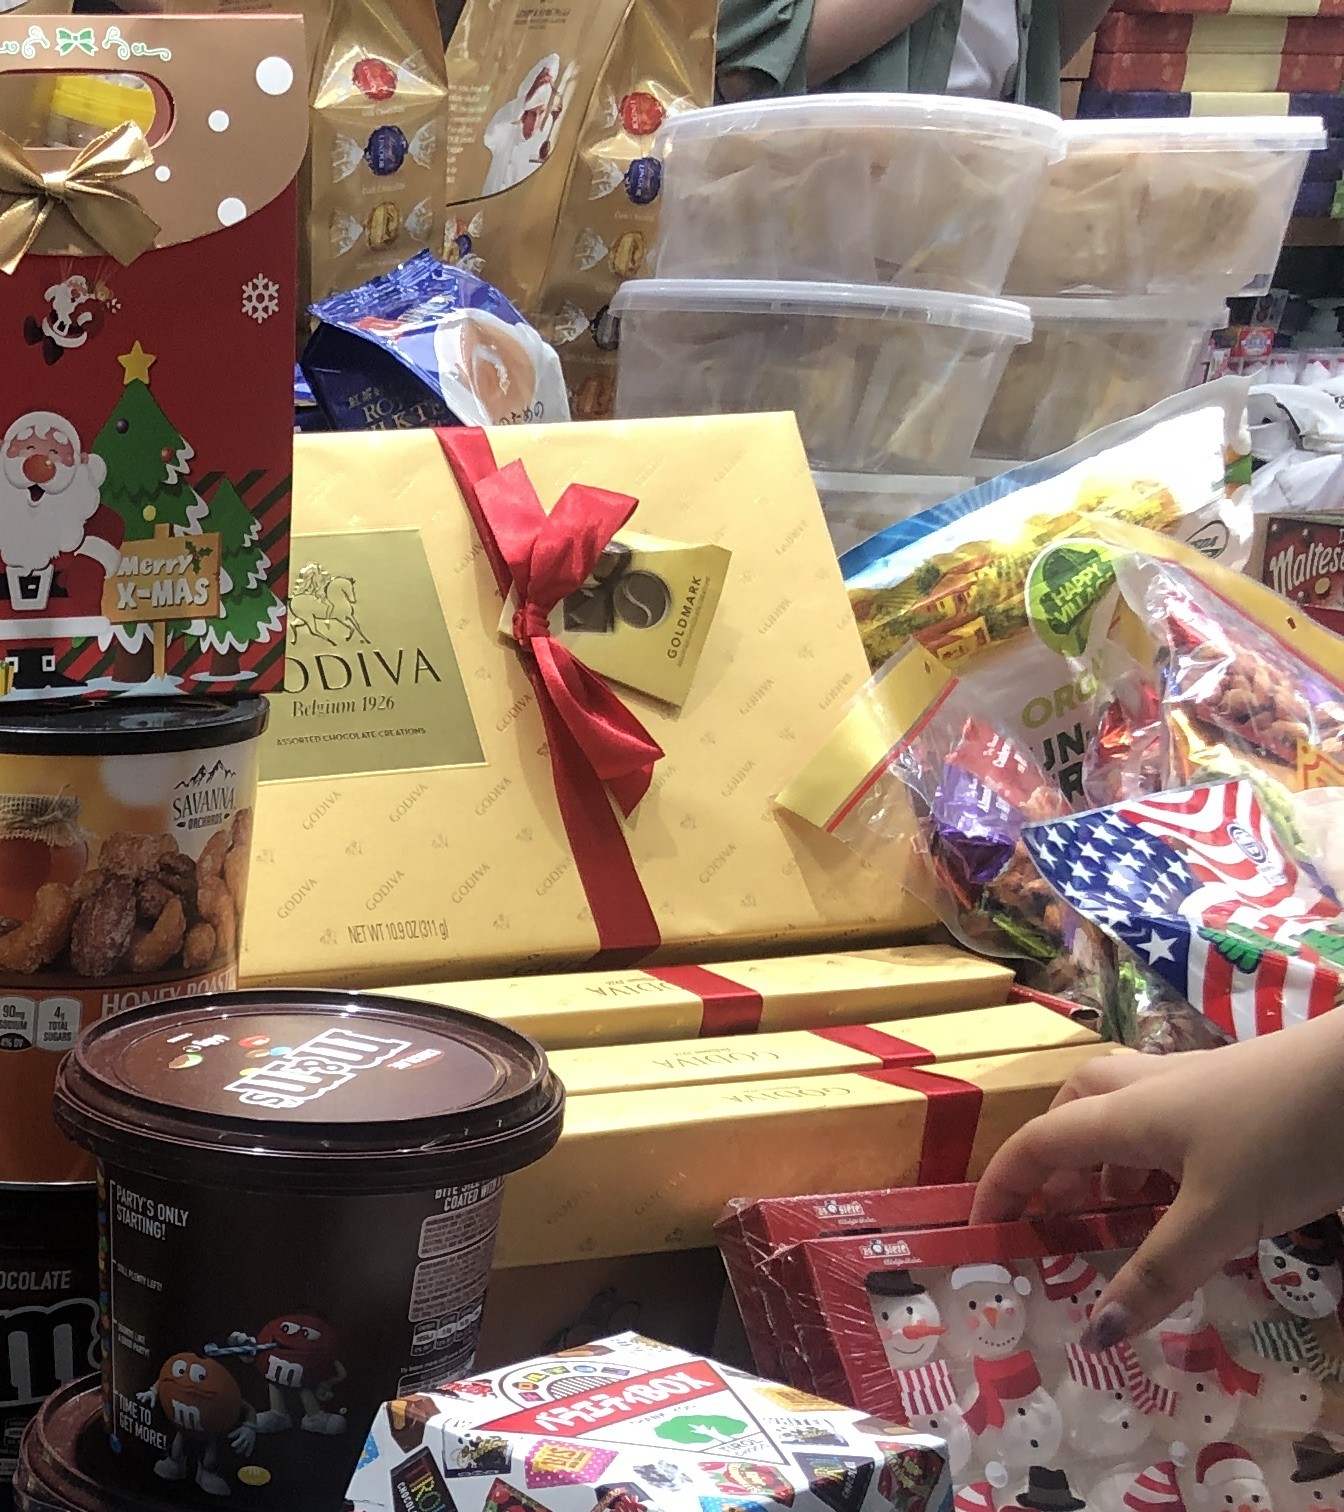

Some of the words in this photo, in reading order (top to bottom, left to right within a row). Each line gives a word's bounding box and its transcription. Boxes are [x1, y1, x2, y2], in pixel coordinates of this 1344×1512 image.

[116, 552, 193, 580] Merry
[116, 577, 211, 610] X-MAS
[1054, 564, 1103, 607] HAPPY
[665, 573, 703, 660] GOLDMARK
[284, 646, 442, 694] ODIVA
[292, 696, 356, 721] Belgium
[362, 694, 395, 713] 1926
[172, 786, 237, 822] SAVANNA
[116, 1184, 154, 1217] PARTY'S
[157, 1203, 189, 1228] ONLY
[116, 1206, 166, 1241] STARTING!
[265, 1354, 304, 1390] m
[119, 1393, 138, 1420] TIME
[140, 1404, 151, 1426] TO
[172, 1398, 204, 1433] m
[119, 1411, 133, 1436] GET
[135, 1421, 167, 1451] MORE!
